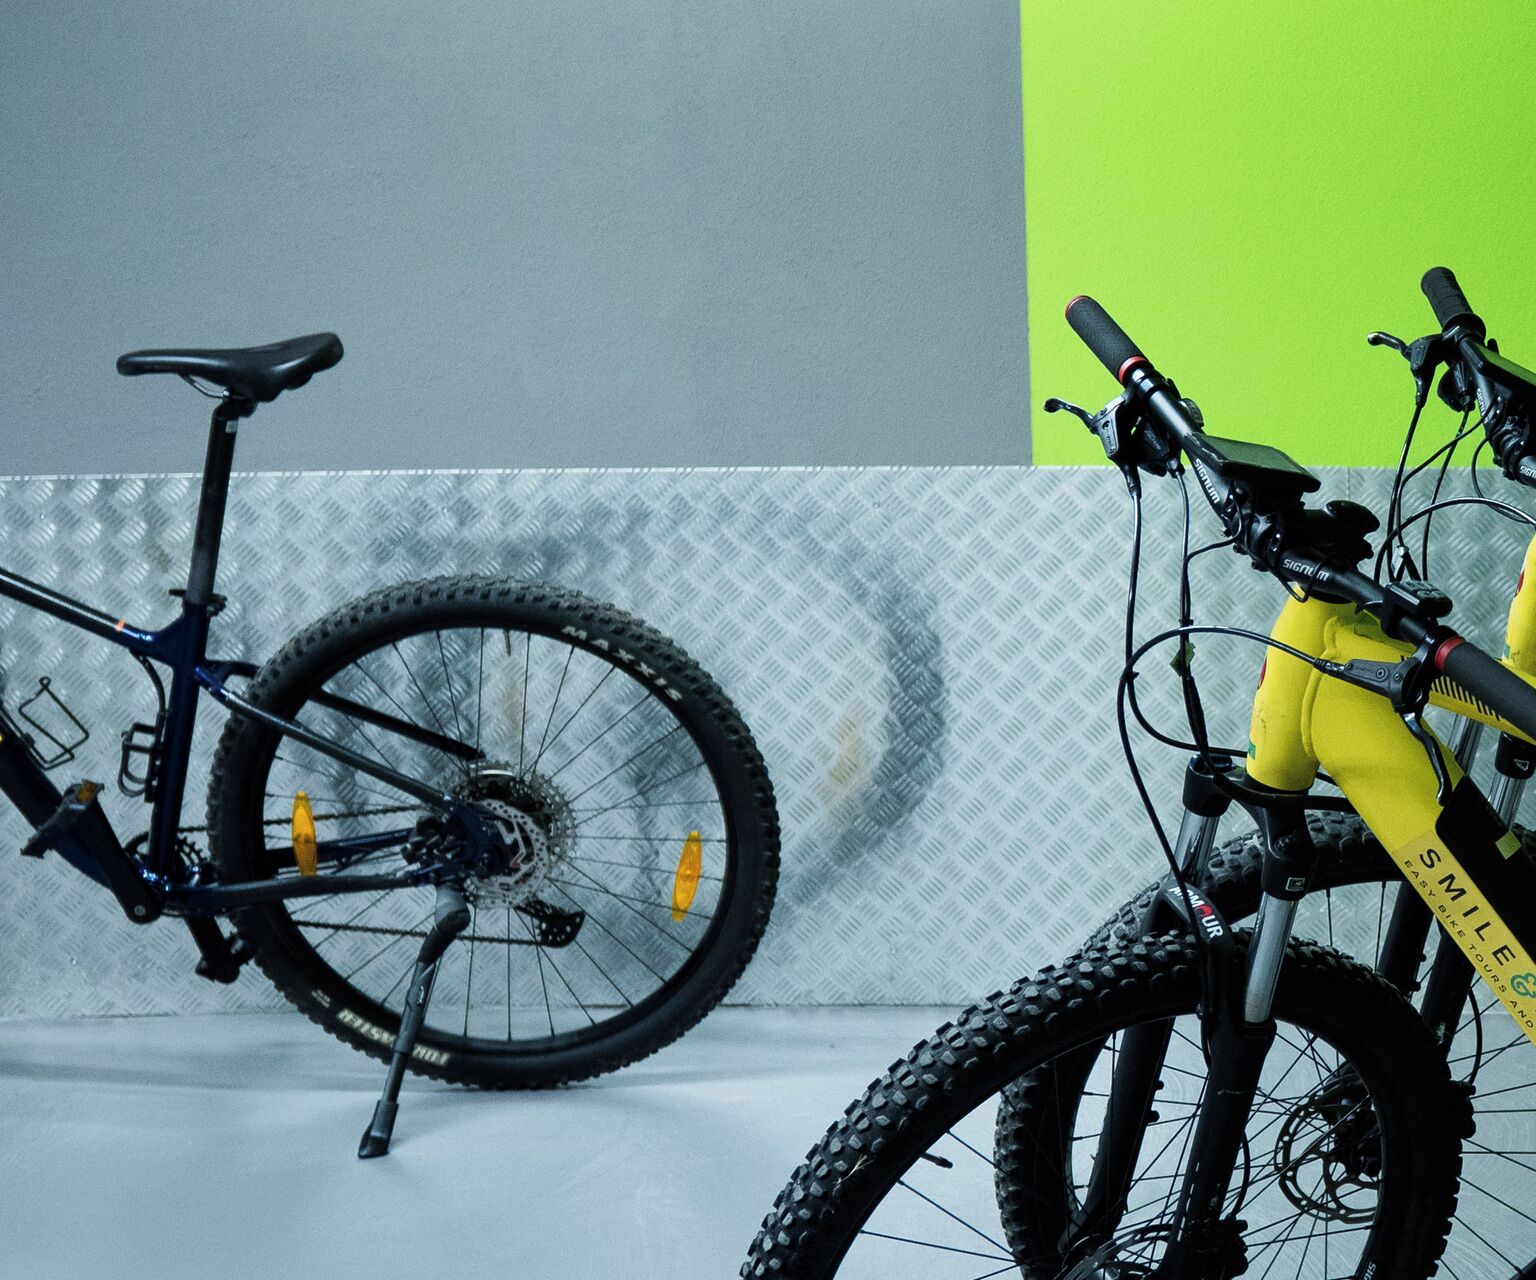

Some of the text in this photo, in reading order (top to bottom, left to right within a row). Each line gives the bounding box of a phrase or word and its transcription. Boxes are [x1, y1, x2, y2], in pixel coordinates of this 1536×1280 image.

[1193, 458, 1220, 504] SIGNUM
[1282, 558, 1330, 581] SIGNUM
[561, 625, 683, 701] MAXXIS
[1169, 886, 1224, 939] AMOUR
[1419, 848, 1516, 966] SMILE
[1404, 860, 1436, 898] EASY
[1438, 904, 1465, 938] BIKE
[1469, 943, 1507, 993] TOURS
[1510, 1000, 1534, 1028] AND
